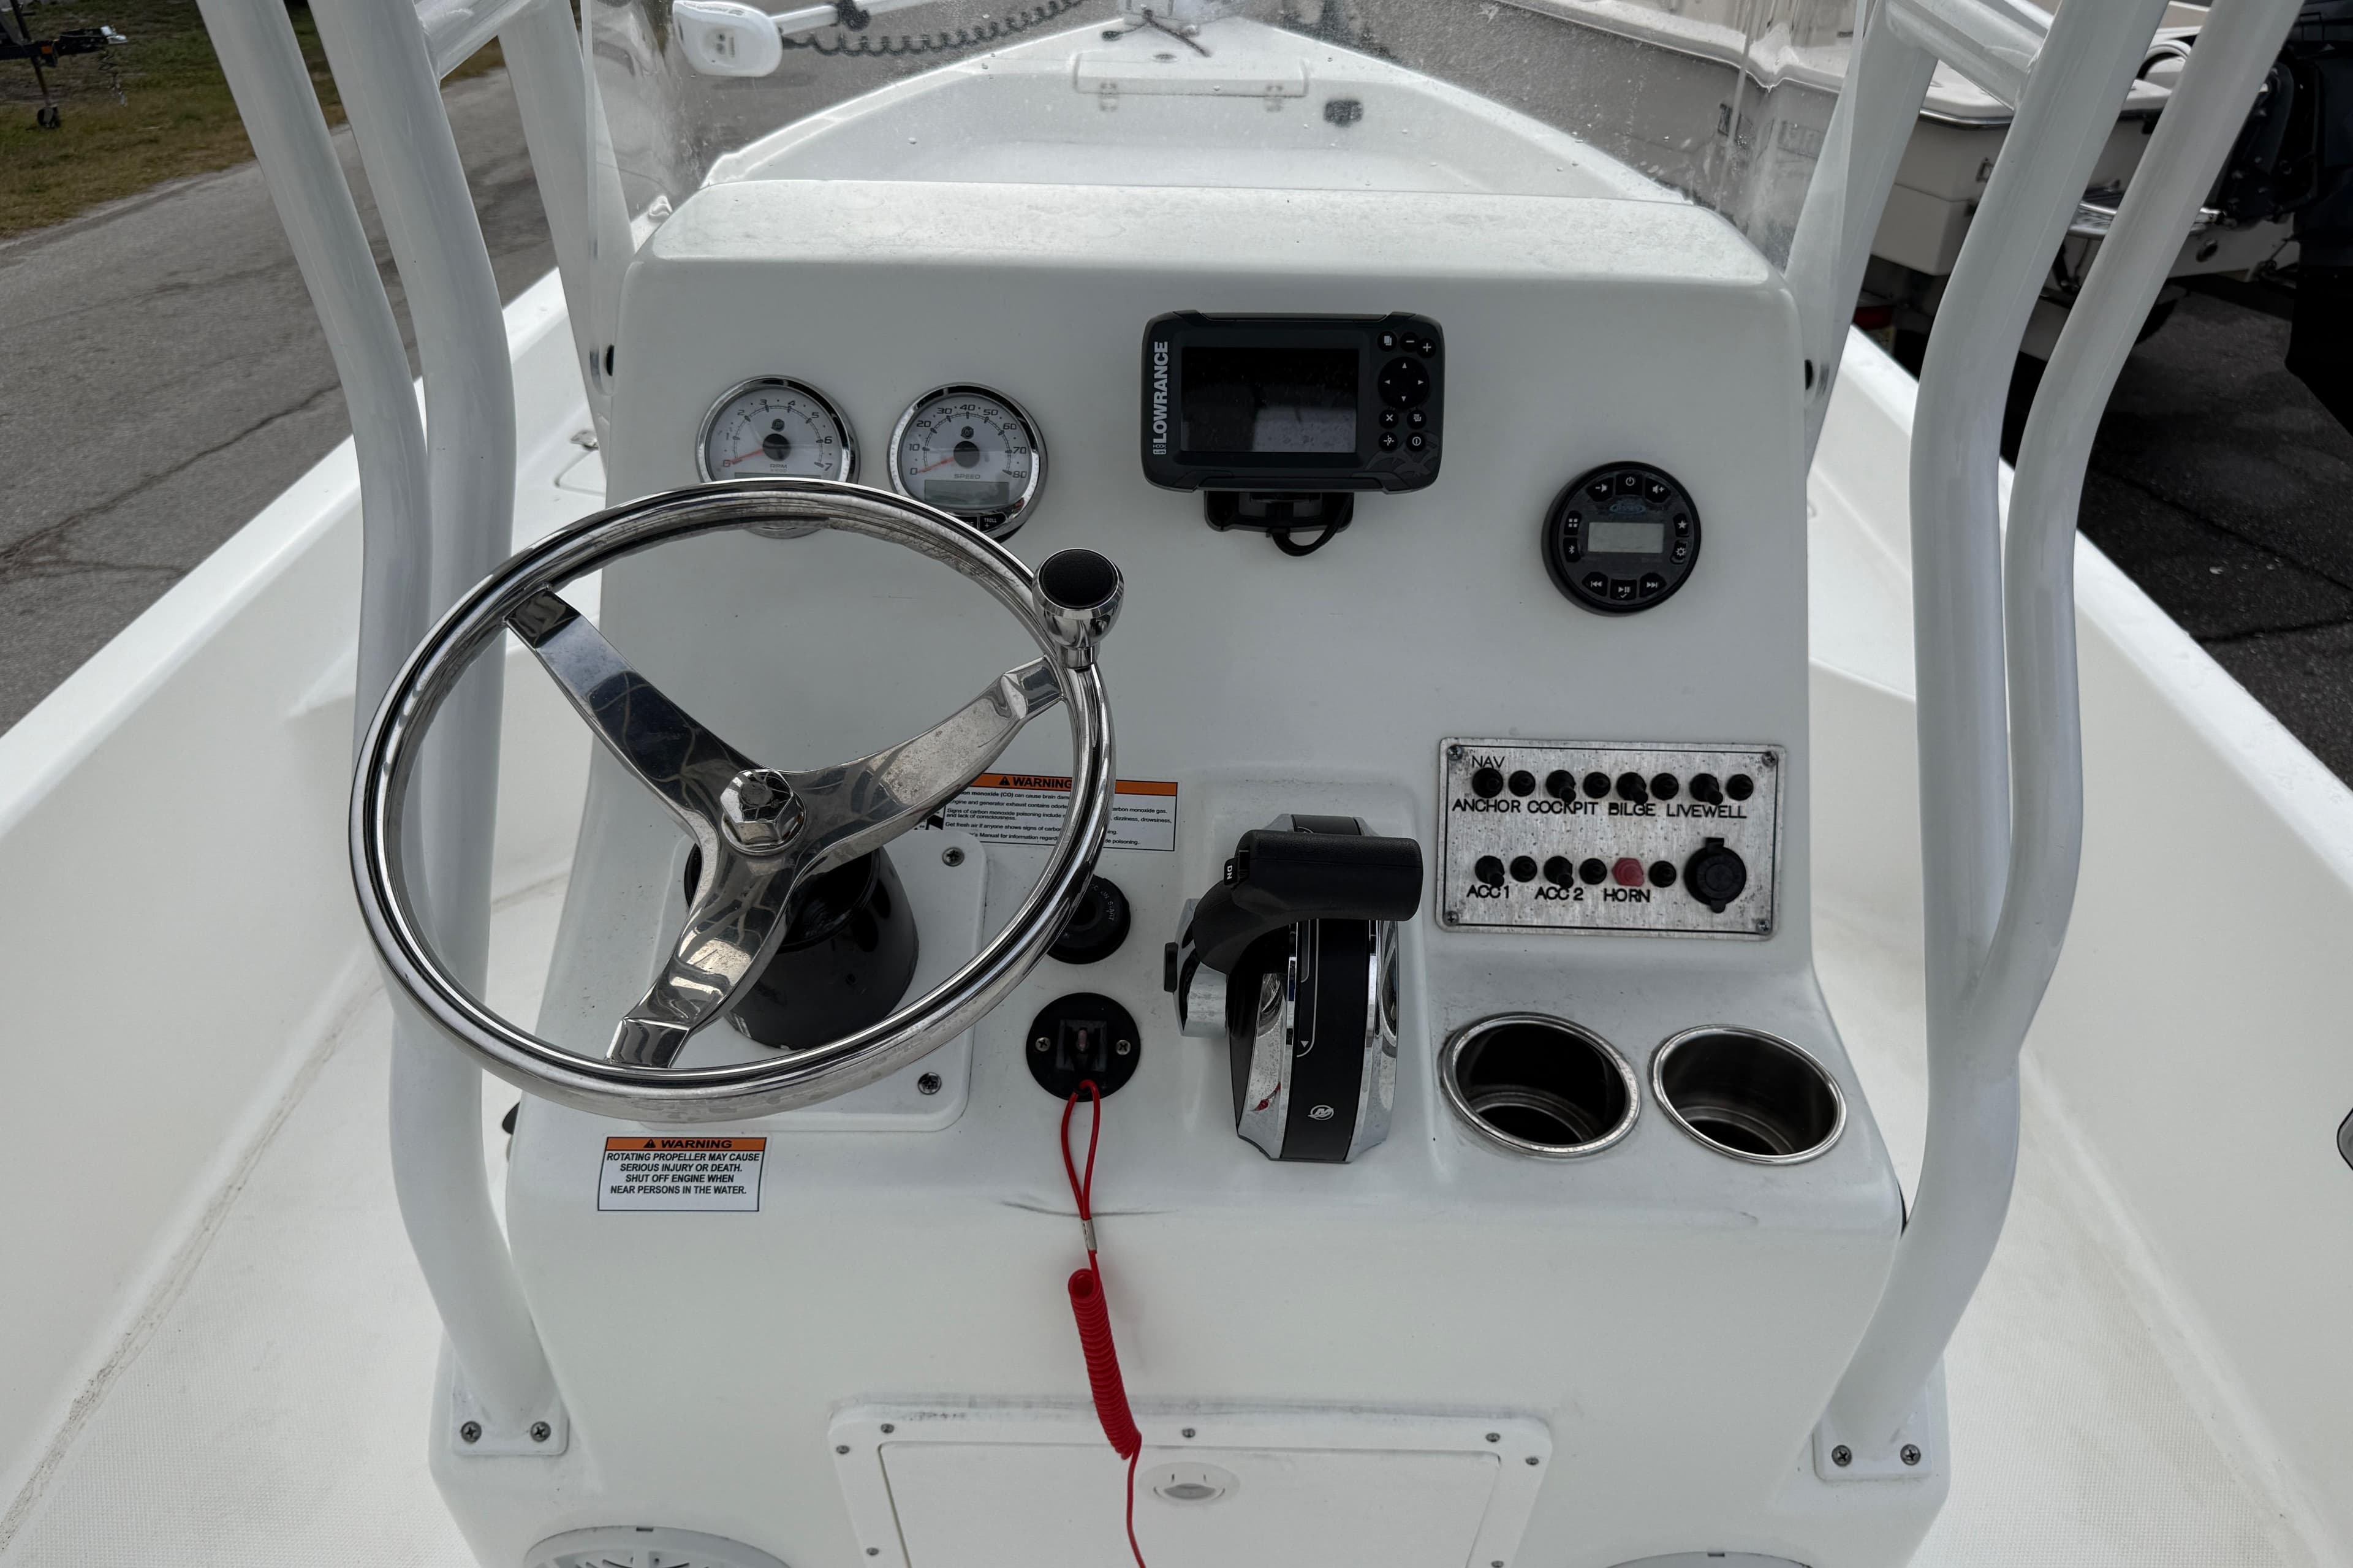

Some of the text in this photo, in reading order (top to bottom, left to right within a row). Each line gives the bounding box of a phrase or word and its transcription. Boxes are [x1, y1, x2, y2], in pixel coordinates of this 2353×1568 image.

[1153, 341, 1168, 444] LOWRANCE
[824, 463, 833, 471] 7
[1472, 756, 1505, 768] NAV
[1013, 776, 1072, 789] WARNING
[1452, 798, 1747, 819] ANCHOR COCKPIT BILGE LIVEWELL
[1227, 865, 1233, 880] DN
[1466, 885, 1650, 903] ACC 1 ACC 2 HORN
[661, 1140, 732, 1148] WARNING
[607, 1153, 651, 1161] ROTATING
[653, 1153, 707, 1161] PROPELLER
[620, 1163, 659, 1172] SERIOUS
[626, 1174, 650, 1183] SHUT
[652, 1174, 670, 1183] OFF
[672, 1174, 706, 1183] ENGINE
[694, 1186, 711, 1194] THE
[714, 1186, 747, 1194] WATER.
